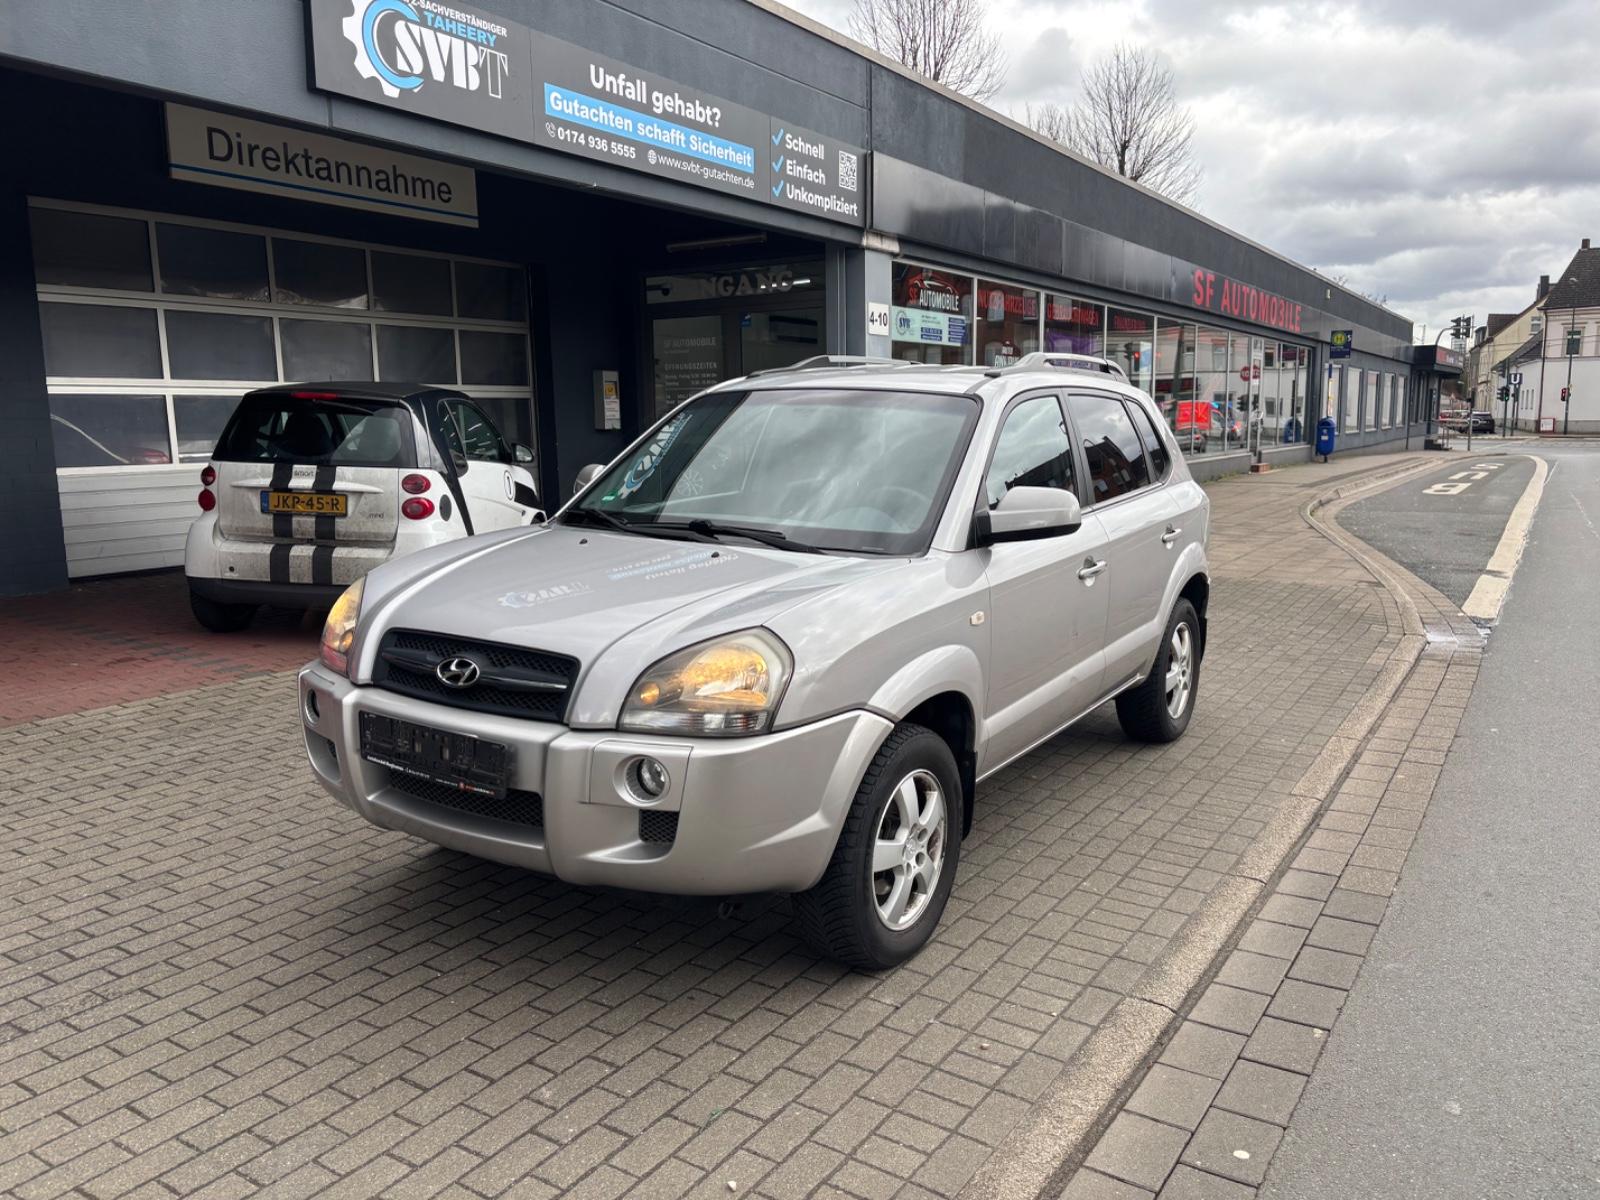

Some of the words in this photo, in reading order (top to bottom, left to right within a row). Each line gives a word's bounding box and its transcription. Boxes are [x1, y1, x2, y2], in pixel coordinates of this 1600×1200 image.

[404, 0, 508, 38] Z-SACHVERSTÄNDIGER
[423, 11, 496, 48] TAHEERY
[396, 20, 508, 99] SVBT
[589, 64, 647, 104] Unfall
[651, 89, 721, 128] gehabt?
[549, 91, 633, 133] Gutachten
[637, 119, 687, 149] schafft
[689, 133, 752, 168] Sicherheit
[557, 126, 586, 144] 0174
[588, 133, 608, 152] 936
[611, 139, 636, 159] 5555
[784, 133, 825, 160] Schnell
[206, 126, 453, 204] Direktannahme
[657, 153, 755, 189] www.svbt-gutachten.de
[786, 159, 826, 186] Einfach
[786, 185, 858, 217] Unkompliziert
[919, 289, 960, 312] AUTOMOBILE
[1193, 268, 1215, 308] SF
[1221, 279, 1302, 332] AUTOMOBILE
[868, 312, 889, 329] 4-10
[1510, 374, 1521, 385] U
[293, 469, 315, 478] smart
[1422, 463, 1505, 495] BUS
[273, 493, 341, 512] JKP-45-R
